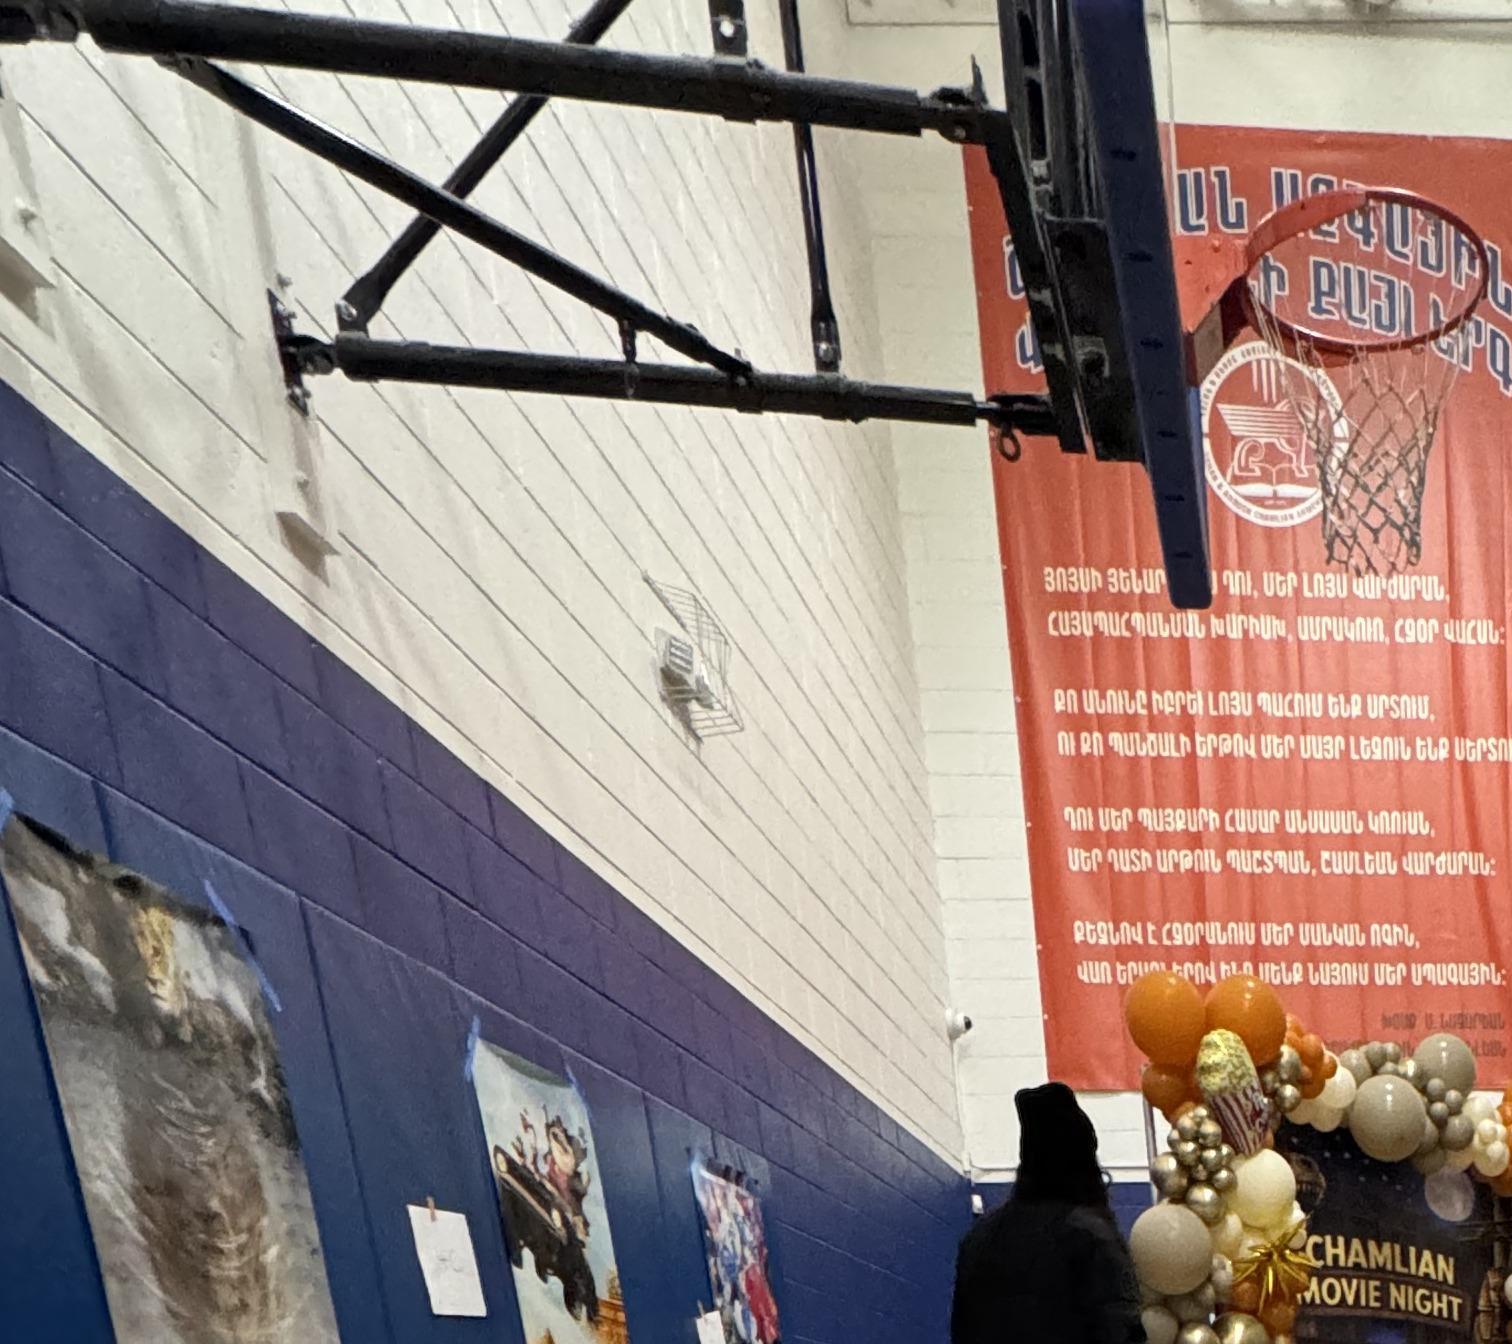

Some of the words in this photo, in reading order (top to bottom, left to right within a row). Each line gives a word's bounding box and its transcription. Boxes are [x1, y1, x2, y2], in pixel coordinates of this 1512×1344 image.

[1262, 571, 1298, 598] ՄԵՐ
[1302, 572, 1348, 599] ԼՈՅՍ
[1053, 688, 1079, 714] ՔՈ
[1207, 690, 1253, 717] ԼՈՅՍ
[1327, 693, 1362, 719] ԵՆՔ
[1080, 731, 1104, 757] ՔՈ
[1260, 734, 1295, 759] ՄԵՐ
[1299, 734, 1346, 760] ՄԱՅՐ
[1415, 736, 1450, 762] ԵՆՔ
[1098, 807, 1133, 832] ՄԵՐ
[1067, 846, 1103, 872] ՄԵՐ
[1106, 848, 1153, 873] ԴԱՏԻ
[1260, 922, 1294, 946] ՄԵՐ
[1374, 962, 1407, 986] ՄԵՐ
[1305, 1234, 1455, 1286] CHAMLIAN
[1297, 1276, 1382, 1308] MOVIE
[1389, 1282, 1463, 1322] NIGHT
